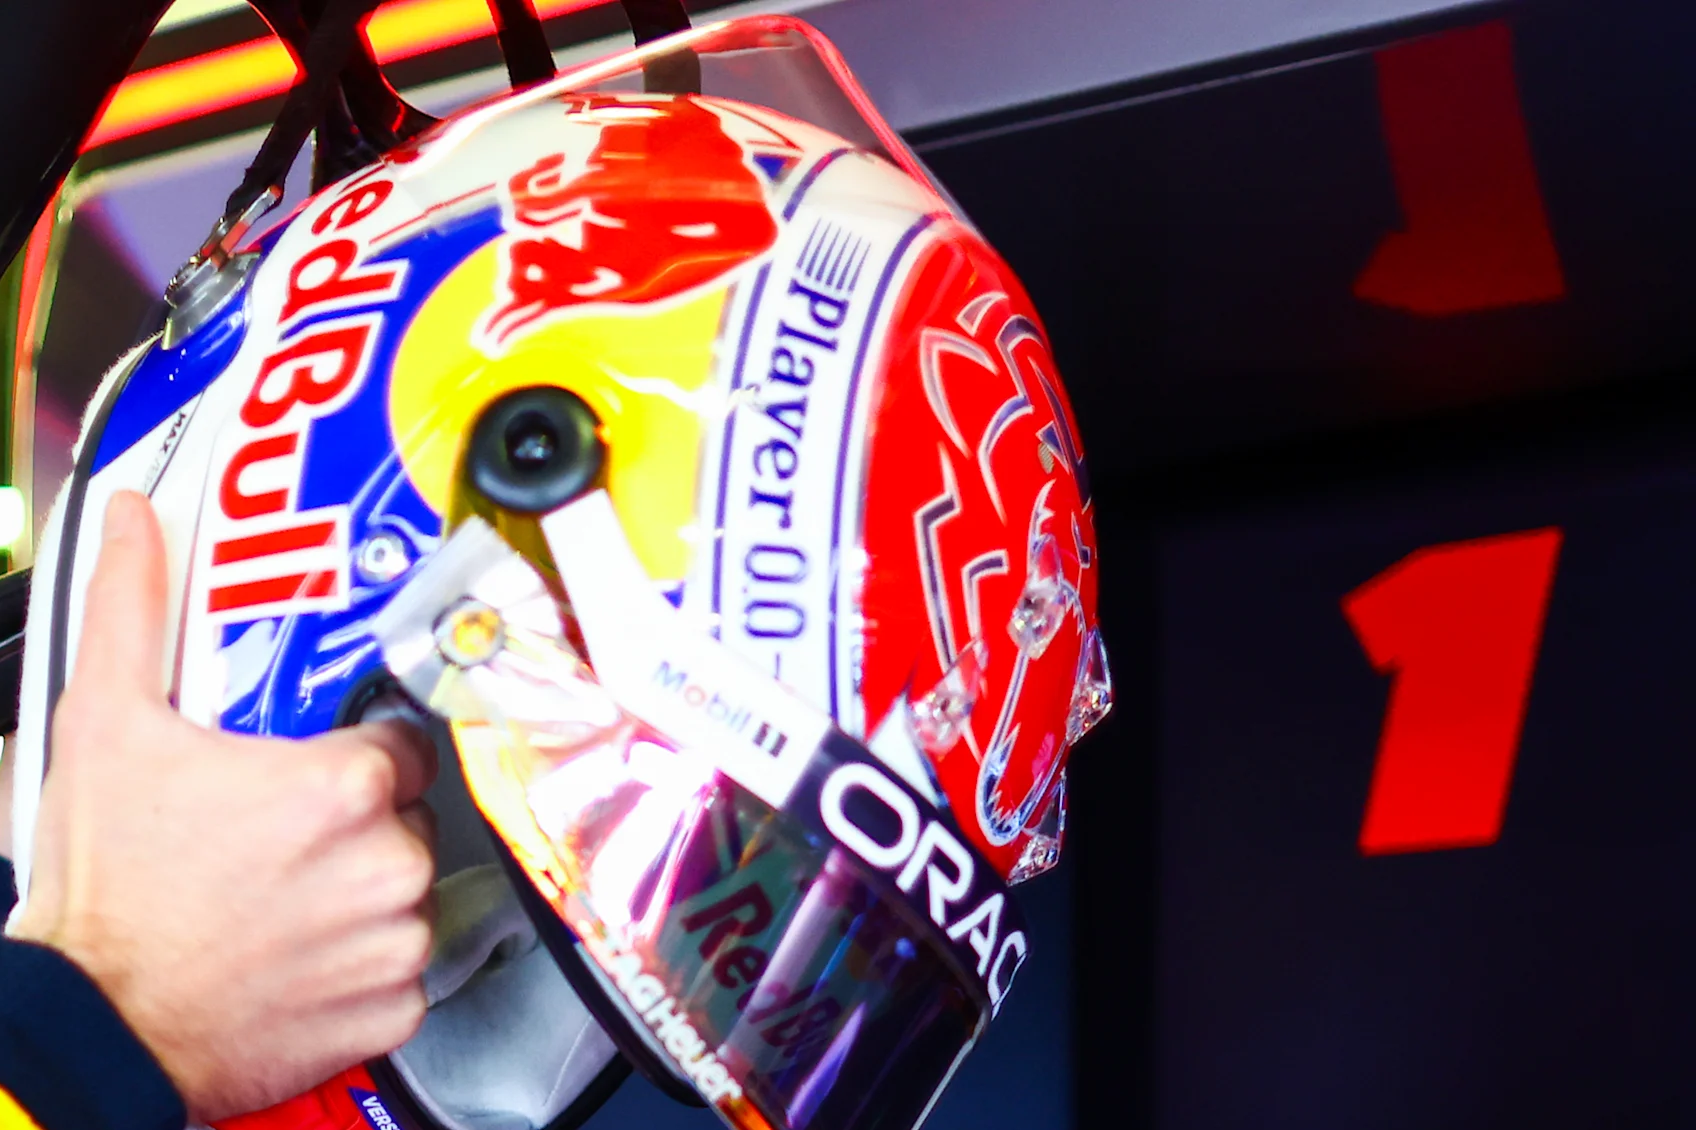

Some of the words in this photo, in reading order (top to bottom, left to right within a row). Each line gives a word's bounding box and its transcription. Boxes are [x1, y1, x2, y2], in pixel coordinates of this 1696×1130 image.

[277, 163, 398, 325] ed
[207, 322, 373, 614] Bull
[748, 277, 850, 530] Player
[653, 661, 752, 733] Mobil
[1341, 525, 1564, 858] 1
[819, 762, 1028, 1014] ORAC
